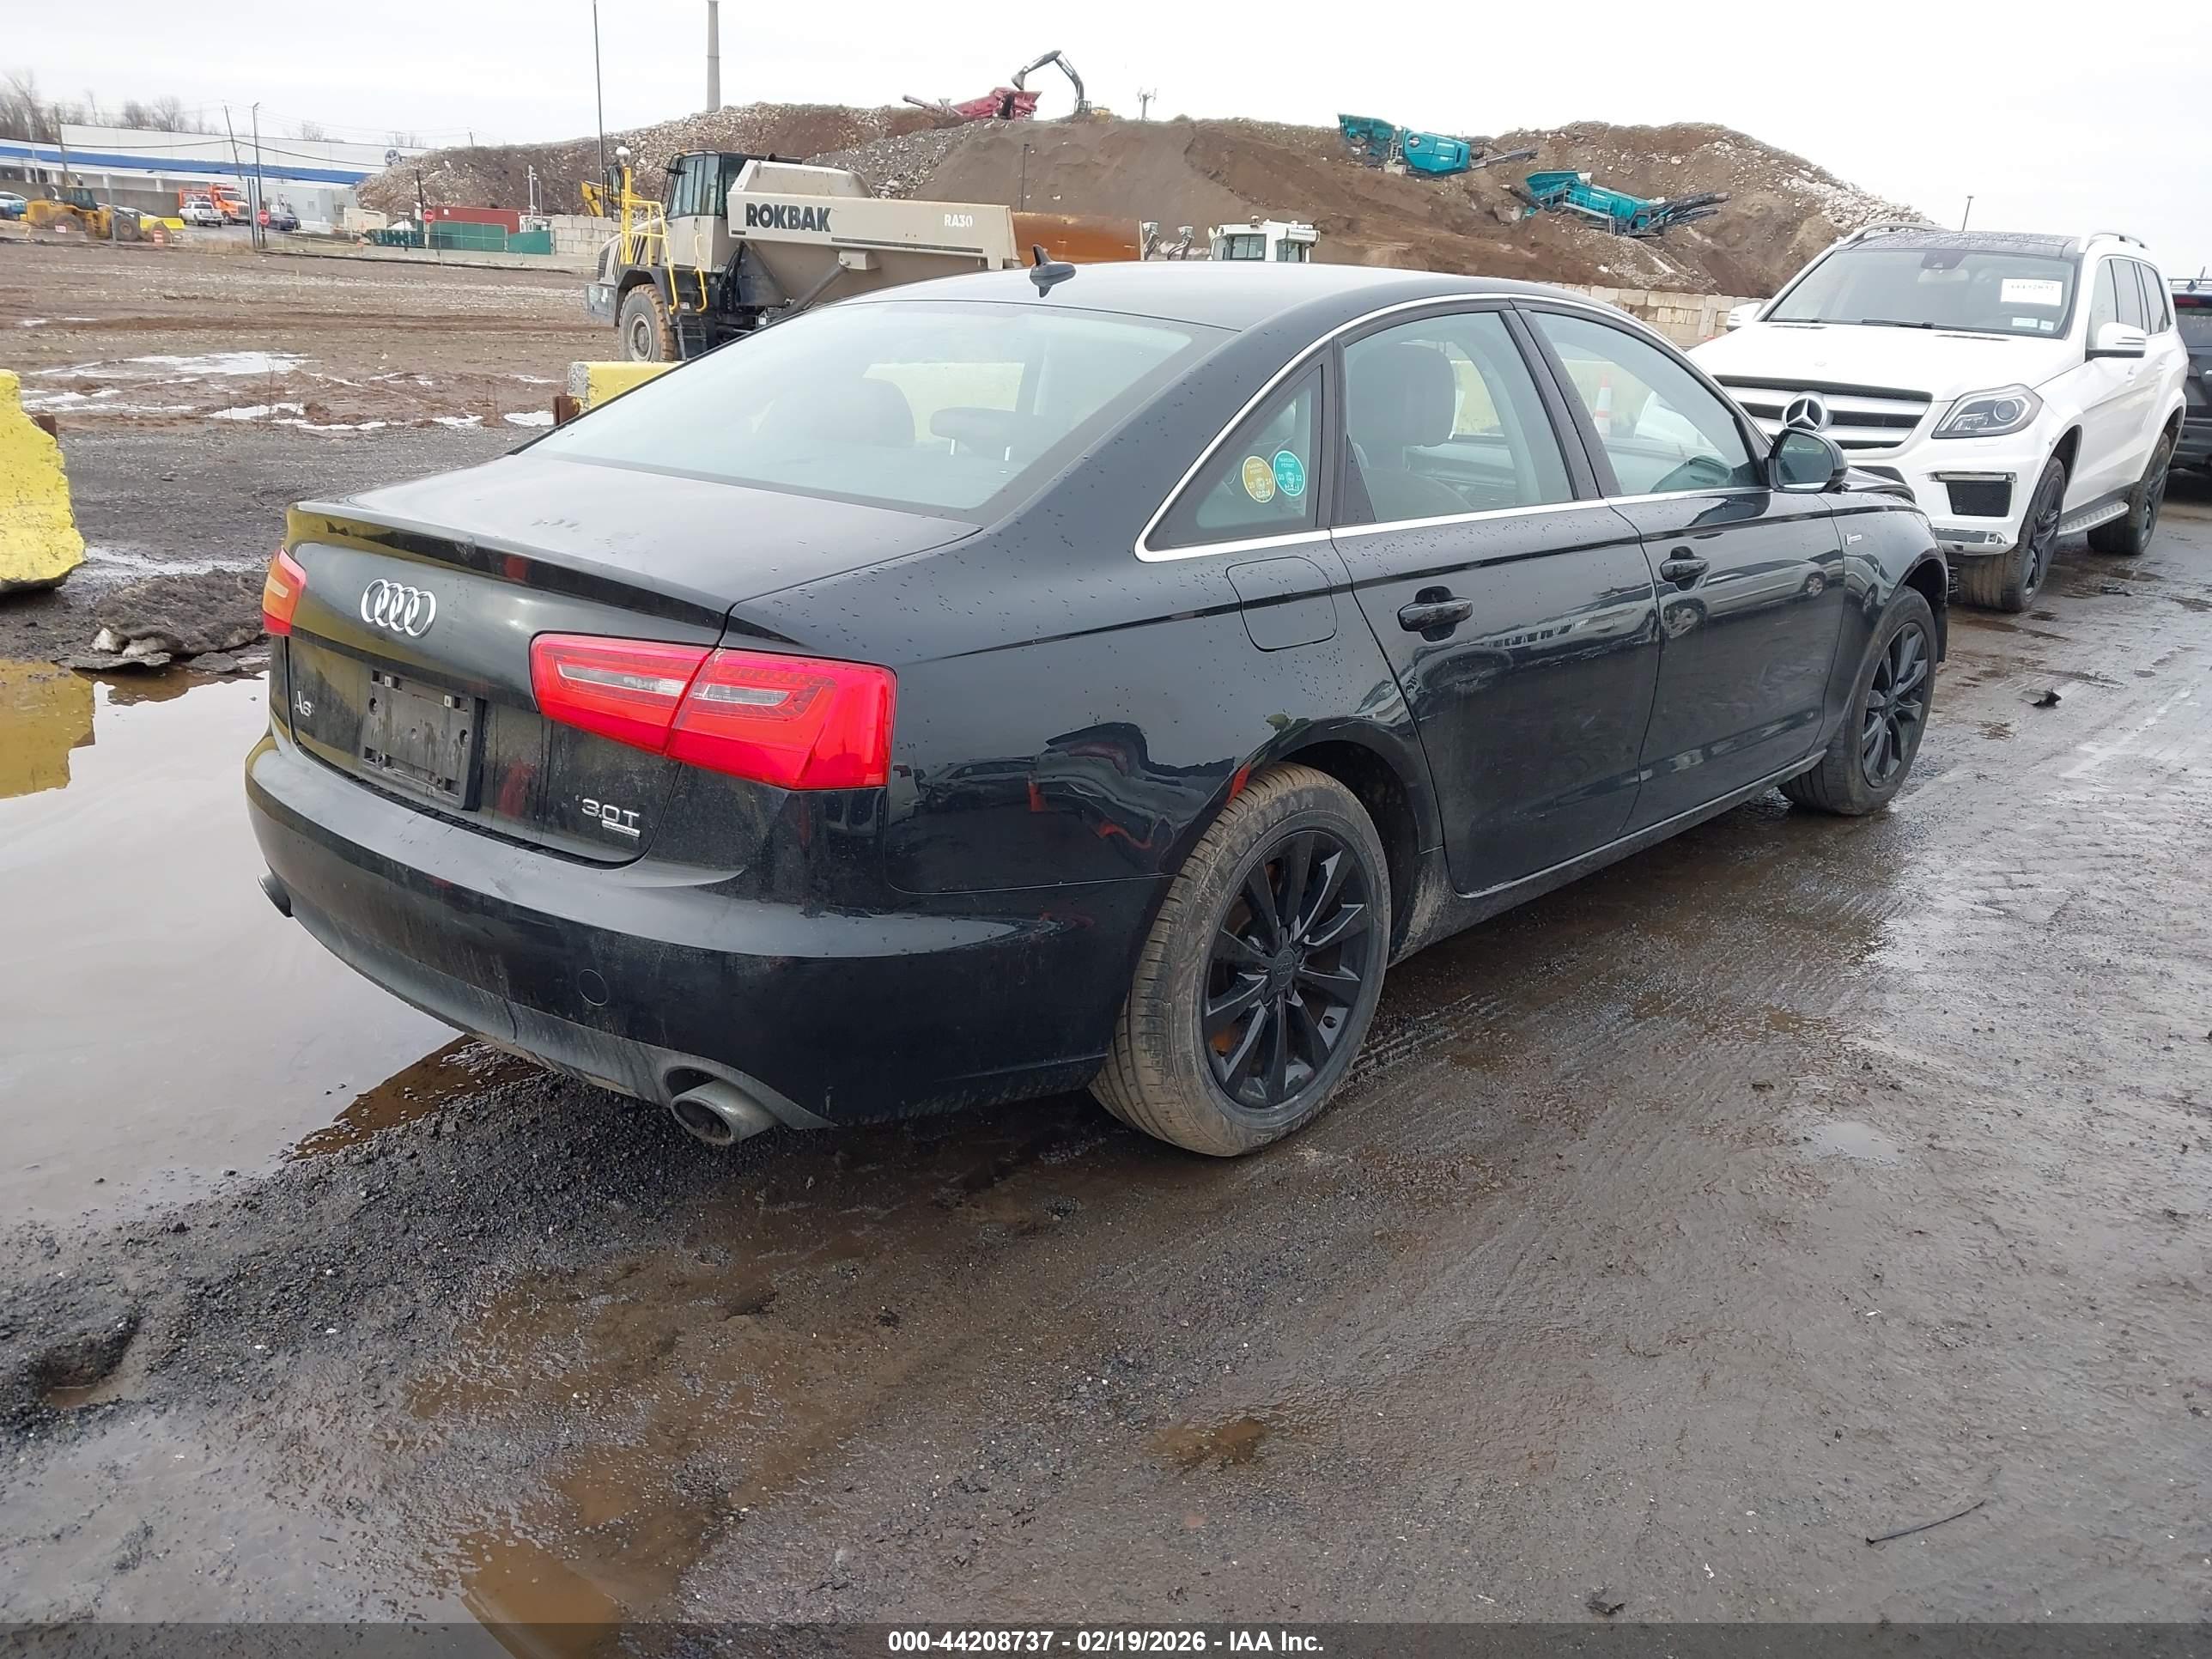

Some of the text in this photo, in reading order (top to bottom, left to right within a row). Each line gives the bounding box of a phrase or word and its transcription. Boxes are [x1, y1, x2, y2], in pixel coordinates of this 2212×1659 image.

[745, 203, 831, 233] ROKBAK
[944, 214, 974, 228] RA30
[294, 690, 313, 717] A6
[581, 798, 641, 828] 3.0T
